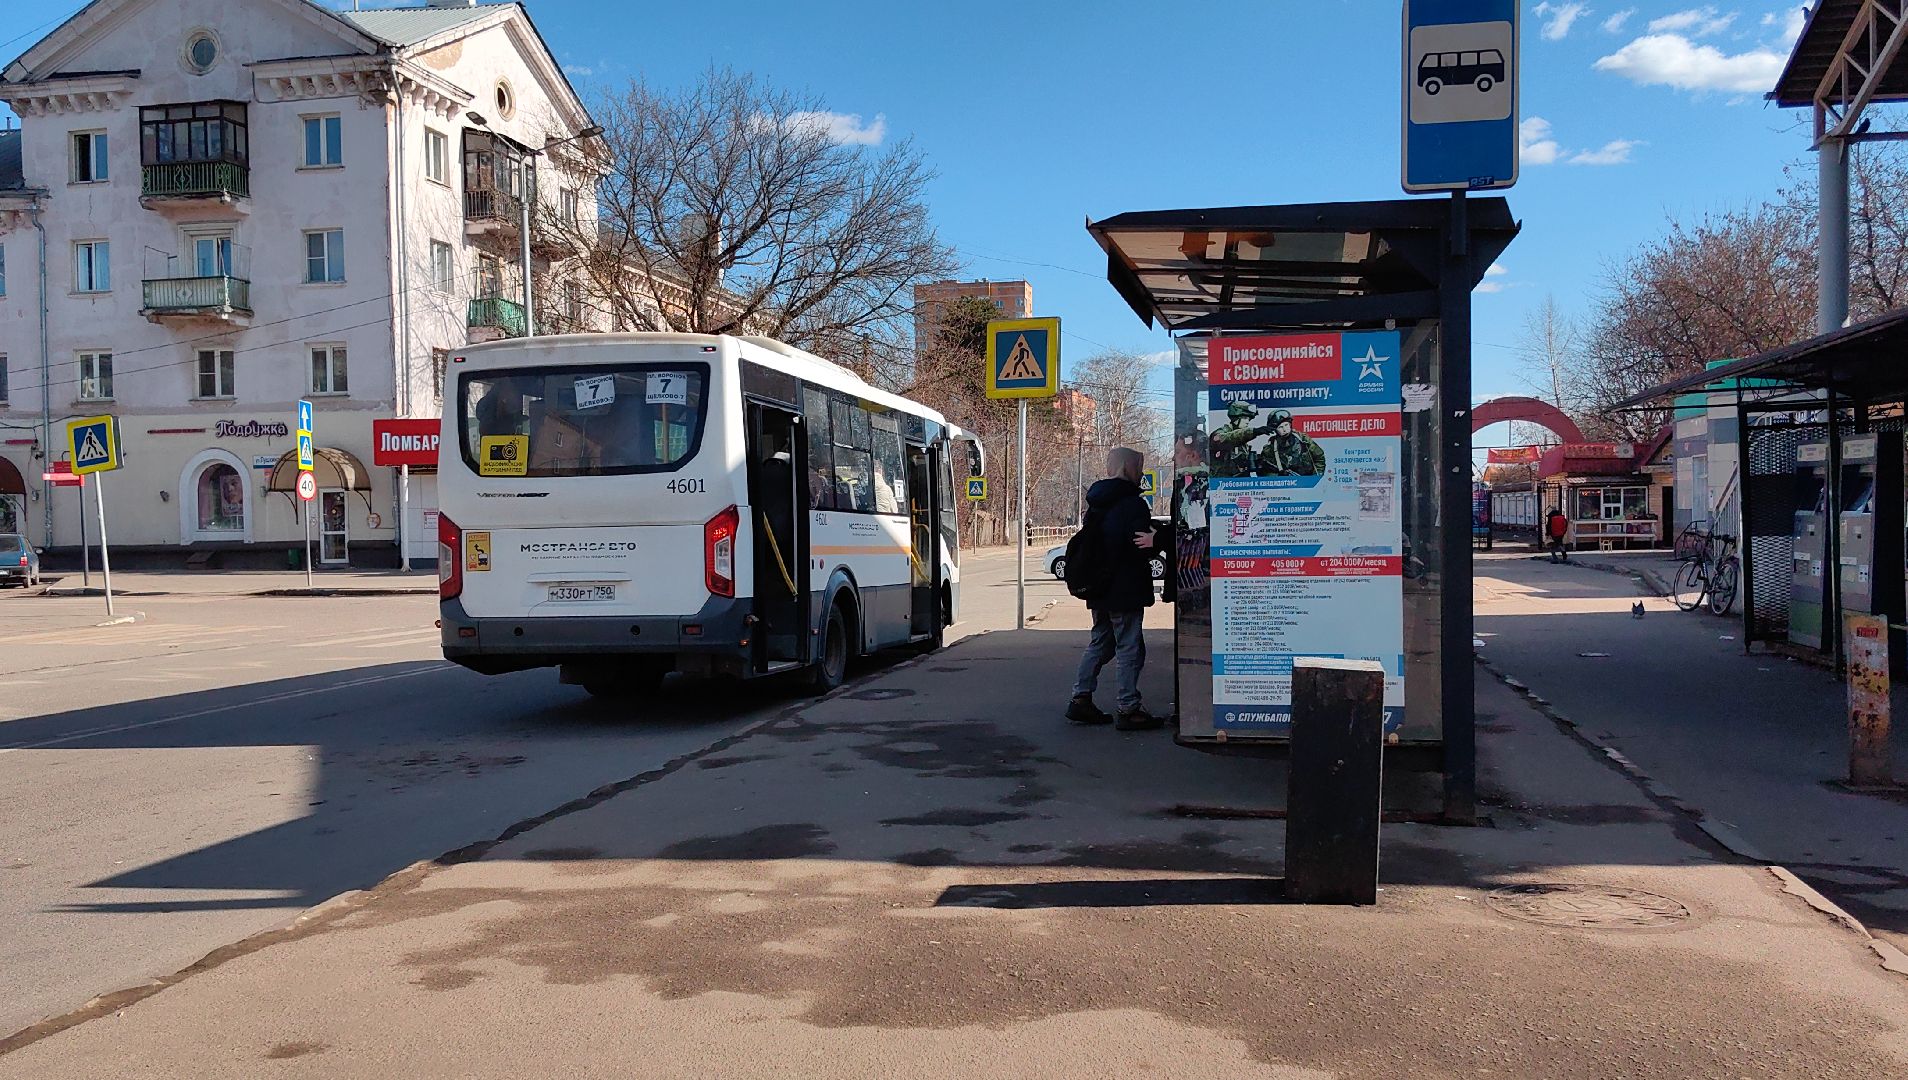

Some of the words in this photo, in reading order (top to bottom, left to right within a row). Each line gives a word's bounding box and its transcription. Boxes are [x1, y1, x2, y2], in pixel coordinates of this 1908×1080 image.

[1224, 343, 1333, 362] Присоединяйся
[1224, 368, 1231, 380] к
[1234, 364, 1284, 380] СВОим!
[588, 384, 600, 399] 7
[660, 379, 671, 393] 7
[1220, 388, 1254, 400] Служи
[1258, 390, 1270, 400] по
[1272, 387, 1332, 400] контракту.
[216, 420, 287, 437] Подружка
[1303, 419, 1358, 432] НАСТОЯЩЕЕ
[1360, 418, 1386, 431] ДЕЛО
[380, 432, 439, 451] ЛОМБАР
[302, 481, 313, 491] 40
[666, 479, 706, 493] 4601
[520, 542, 636, 552] МОСТРАНСАВТО
[1224, 560, 1235, 569] 195
[1236, 560, 1249, 568] 000
[1271, 560, 1285, 568] 405
[1286, 560, 1299, 568] 000
[1330, 558, 1343, 566] 204
[550, 588, 592, 599] М330РТ
[595, 587, 611, 595] 750
